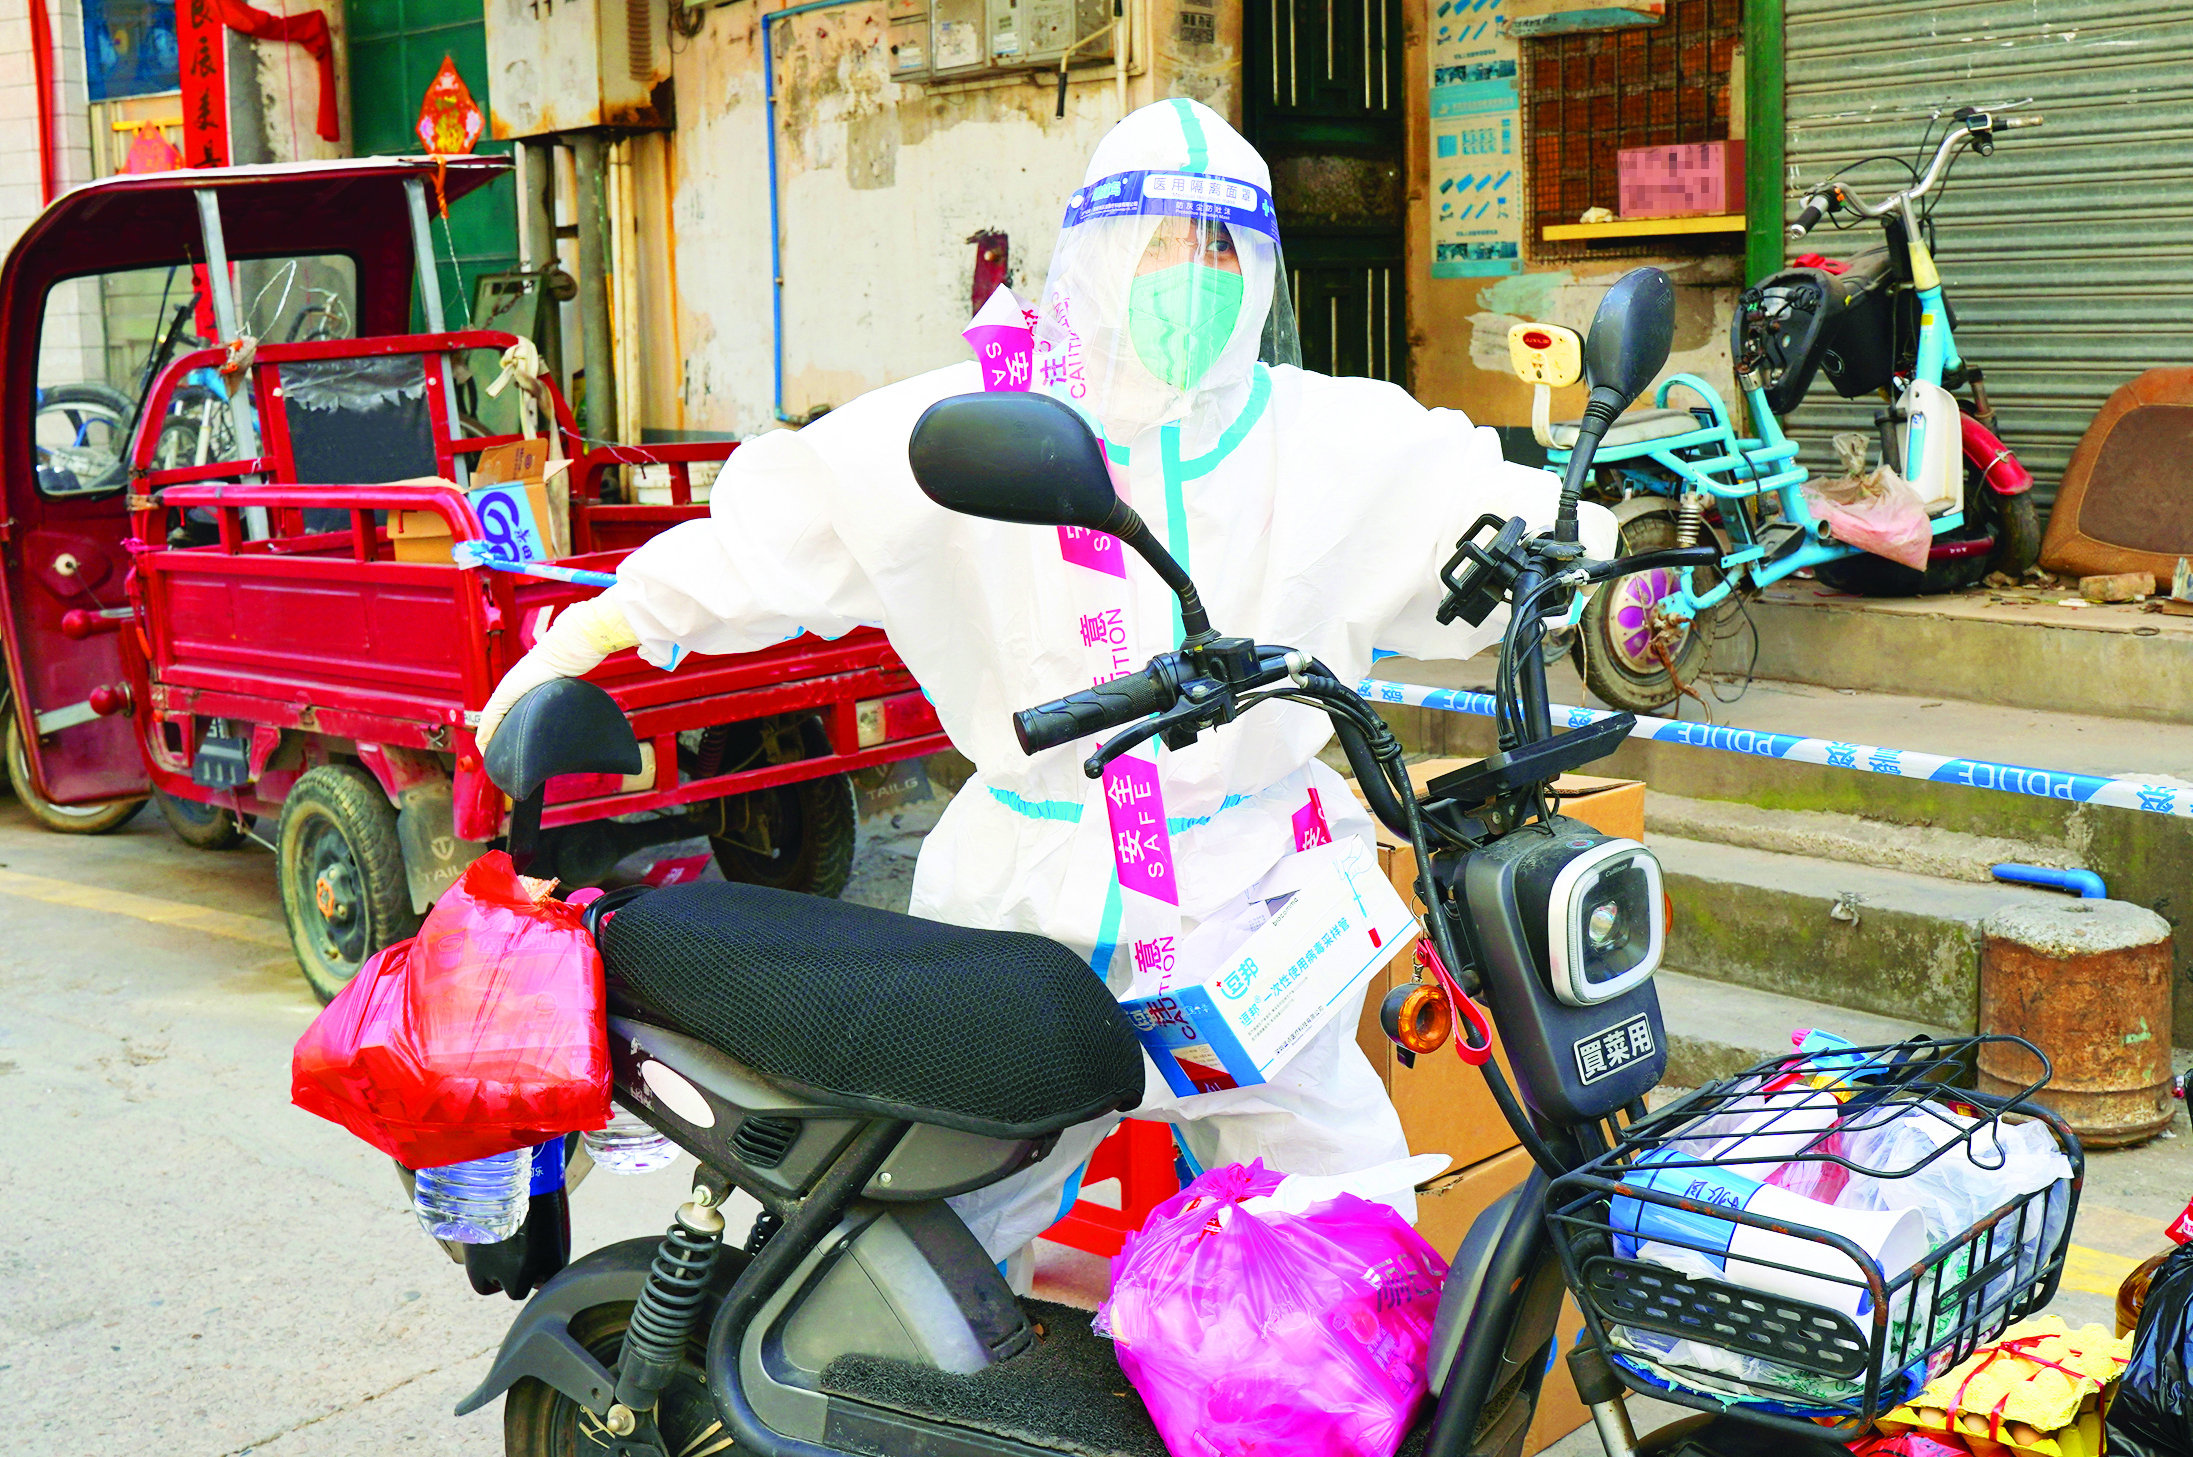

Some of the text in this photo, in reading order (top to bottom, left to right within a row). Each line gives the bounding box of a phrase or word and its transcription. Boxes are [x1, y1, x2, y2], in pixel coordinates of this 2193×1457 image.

[1154, 177, 1251, 202] 医用隔离面罩
[985, 342, 1006, 387] SA
[1005, 351, 1030, 387] 安
[1040, 355, 1067, 387] 注
[1675, 722, 1776, 757] POLICE
[866, 777, 919, 800] TAILG
[1957, 760, 2076, 801] POLICE
[1108, 775, 1145, 864] 安全
[1134, 781, 1165, 878] SAFE
[1272, 896, 1299, 927] biocomma
[1159, 936, 1197, 1040] CAUTION
[1579, 1019, 1652, 1079] 買菜用
